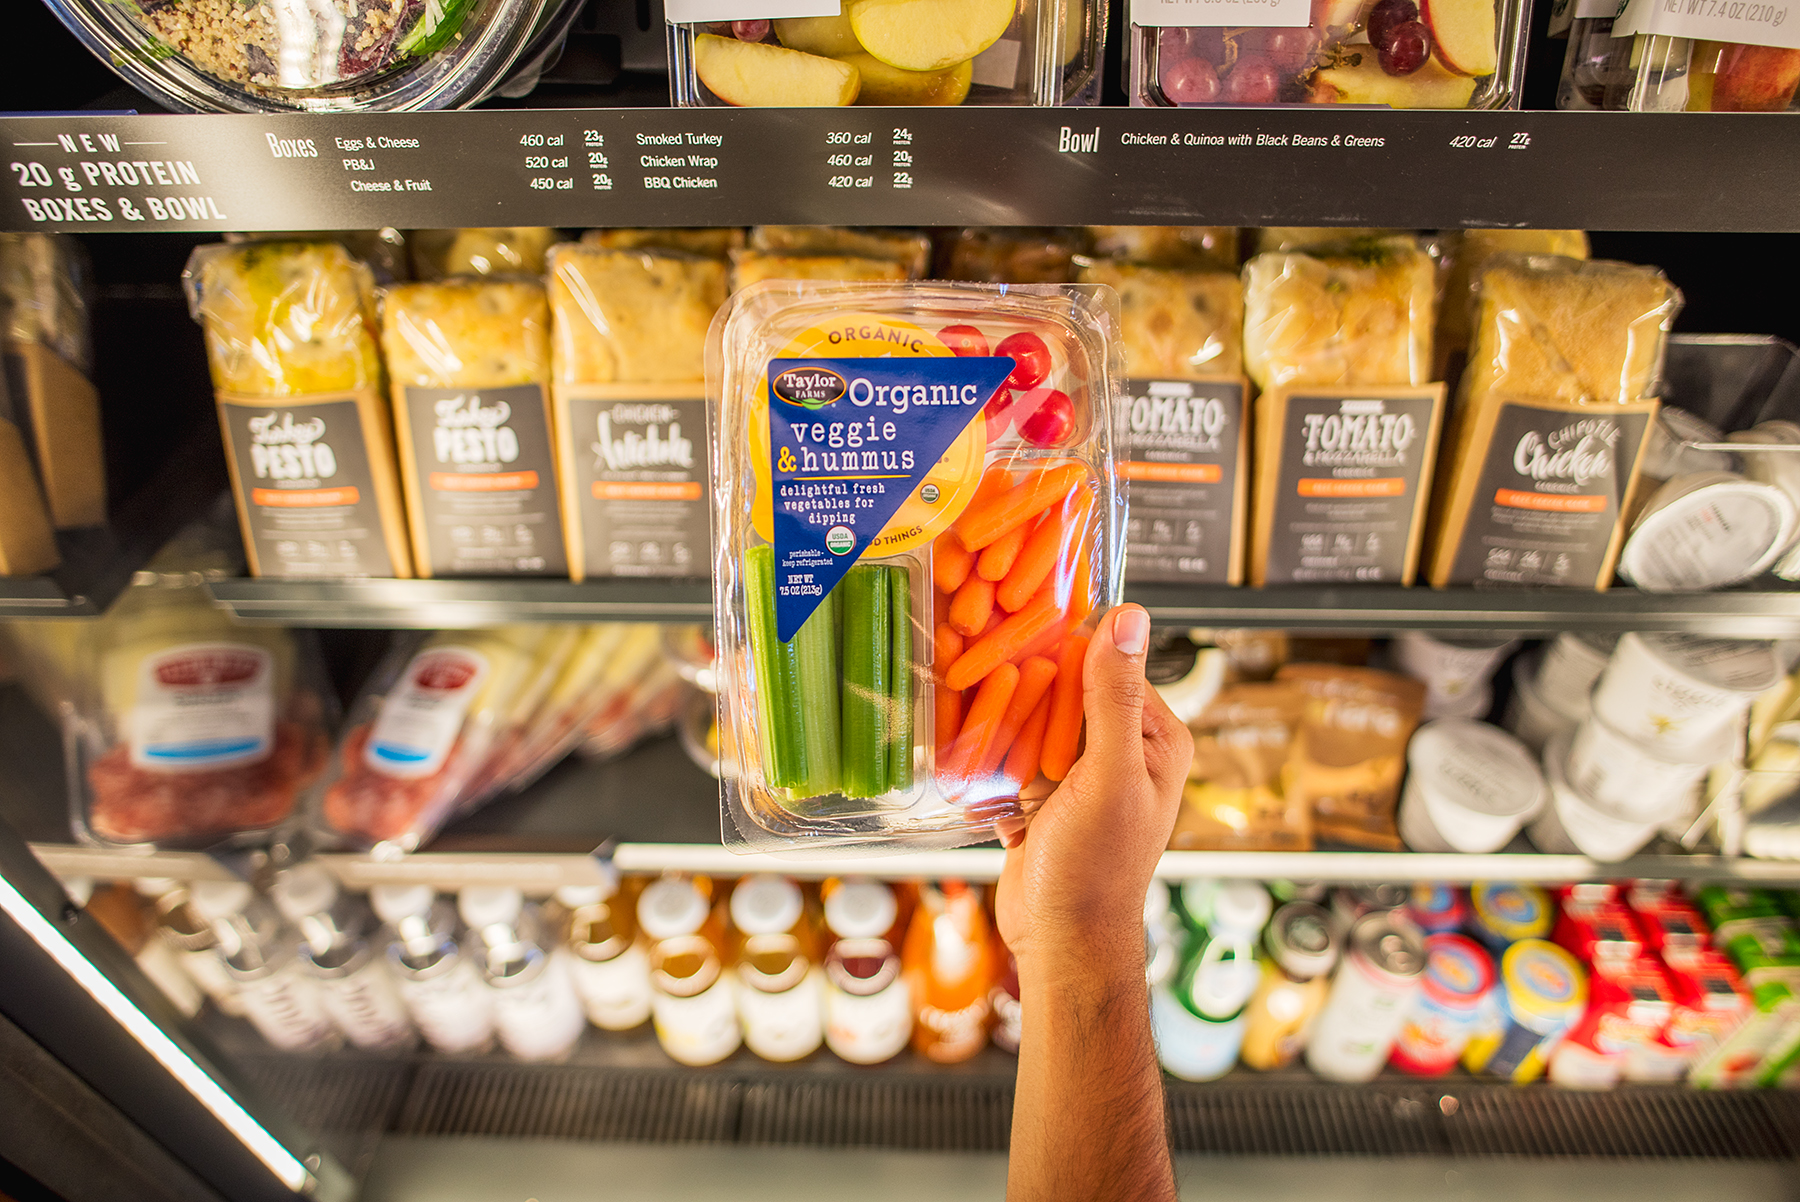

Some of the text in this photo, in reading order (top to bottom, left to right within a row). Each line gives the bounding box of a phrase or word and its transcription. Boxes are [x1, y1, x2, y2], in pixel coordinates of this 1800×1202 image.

[1707, 0, 1727, 17] 7.4
[1728, 2, 1746, 20] OZ
[1746, 4, 1775, 22] (210
[1772, 7, 1788, 27] g)
[265, 132, 319, 158] Boxes
[335, 136, 420, 151] Eggs & Cheese
[519, 134, 564, 147] 460 cal
[636, 133, 723, 147] Smoked Turkey
[825, 132, 872, 145] 360 cal
[1058, 126, 1100, 153] Bowl
[1120, 132, 1386, 148] Chicken & Quinoa with Black Beans & Greens
[1449, 135, 1499, 149] 420 cal
[342, 159, 376, 171] PB&J
[525, 156, 569, 169] 520 cal
[640, 155, 719, 169] Chicken Wrap
[826, 154, 873, 167] 460 cal
[10, 161, 201, 192] 20 g PROTEIN
[529, 178, 574, 190] 450 cal
[643, 176, 718, 189] BBQ Chicken
[828, 175, 874, 188] 420 cal
[350, 179, 433, 192] Cheese & Fruit
[22, 197, 228, 222] BOXES & BOWL
[828, 326, 923, 353] ORGANIC
[783, 374, 836, 391] Taylor
[795, 390, 826, 398] FARMS
[848, 378, 977, 414] Organic
[790, 416, 897, 448] veggie
[1303, 413, 1411, 450] TOMATO
[1547, 418, 1622, 450] CHIPOTLE
[433, 426, 519, 463] PESTO
[250, 442, 338, 479] PESTO
[777, 446, 915, 472] & hummus
[1513, 430, 1612, 486] Chicken
[780, 483, 885, 498] delightful fresh
[784, 497, 874, 512] vegetables for
[808, 512, 856, 525] dipping
[884, 525, 923, 545] THINGS
[788, 574, 814, 584] NET WT
[790, 586, 801, 595] OZ
